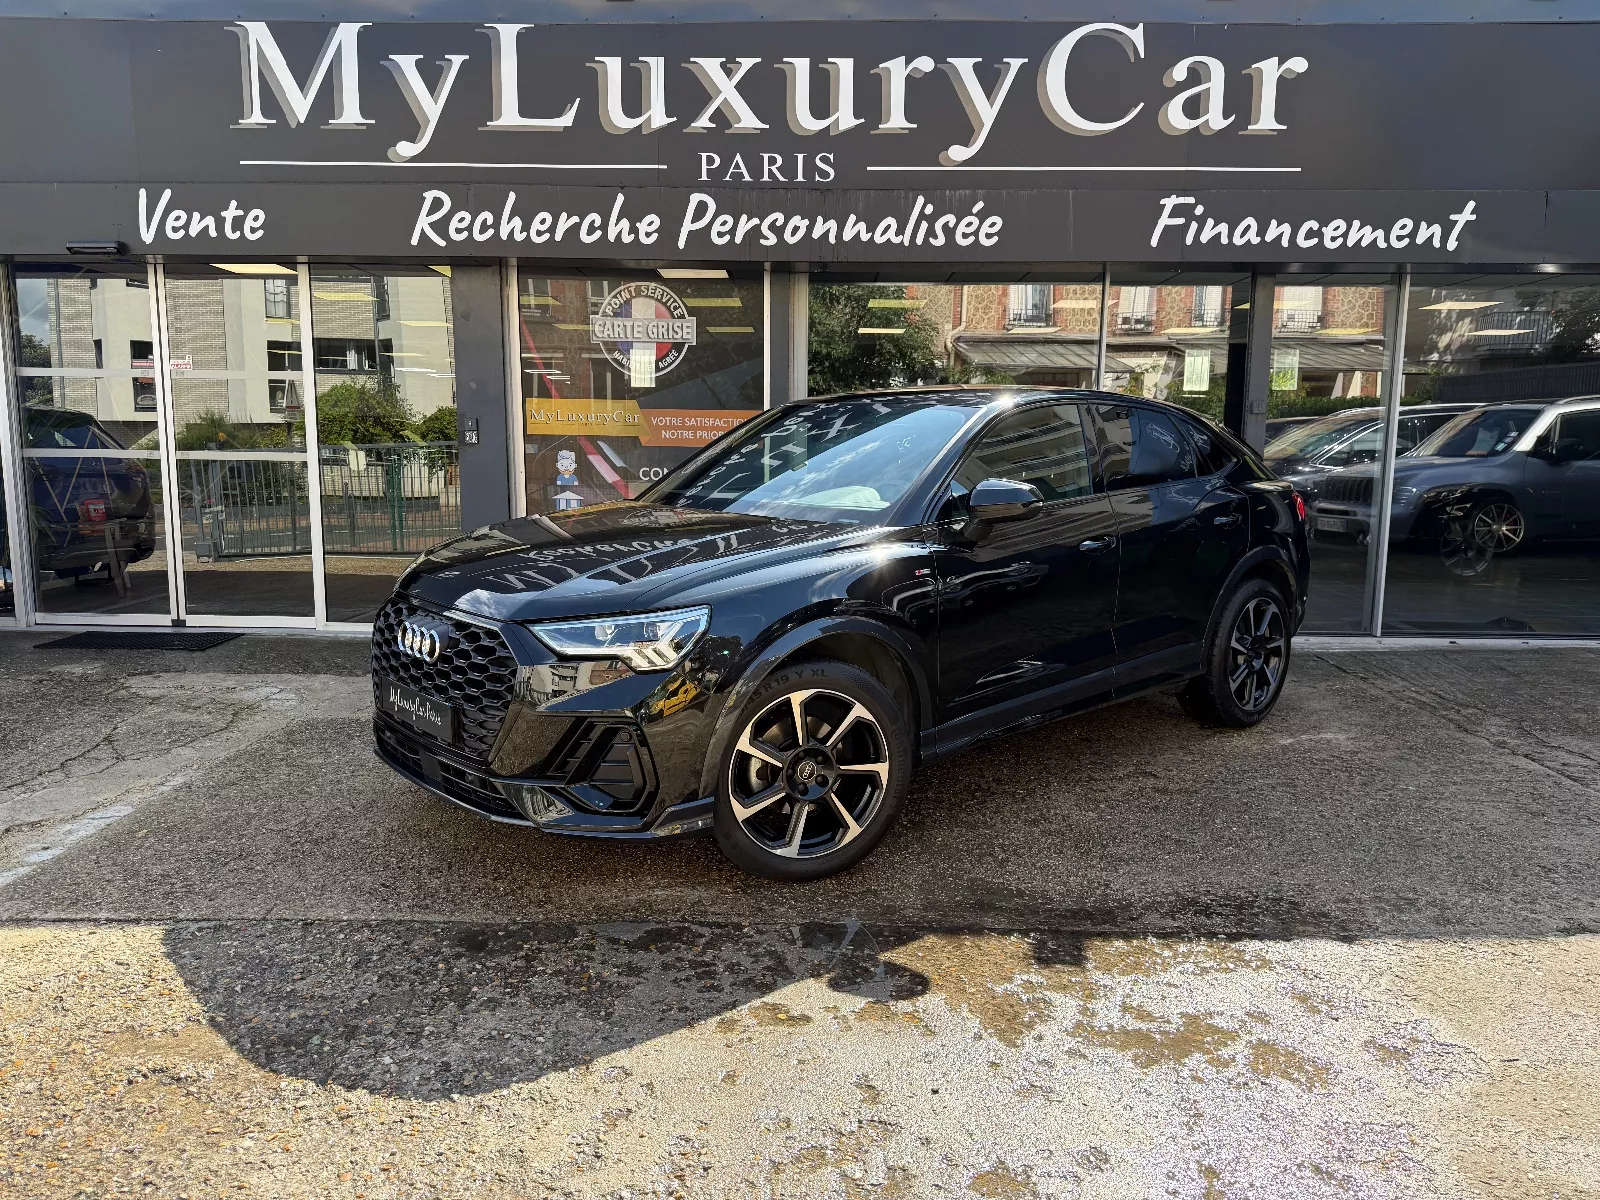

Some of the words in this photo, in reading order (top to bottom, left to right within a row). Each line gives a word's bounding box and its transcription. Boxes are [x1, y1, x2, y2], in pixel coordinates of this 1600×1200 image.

[225, 21, 1310, 163] MyLuxuryCar
[697, 152, 835, 182] PARIS
[138, 187, 266, 245] Vente
[410, 189, 661, 247] Recherche
[677, 192, 1003, 250] Personnalisée
[1150, 194, 1477, 252] Financement
[605, 286, 636, 316] POINT
[640, 285, 684, 318] SERVICE
[594, 320, 643, 338] CARTE
[647, 321, 692, 339] GRISE
[530, 409, 640, 425] MyLuxuryCar
[651, 416, 682, 426] VOTRE
[684, 417, 747, 427] SATISFACTIO
[661, 429, 695, 439] NOTRE
